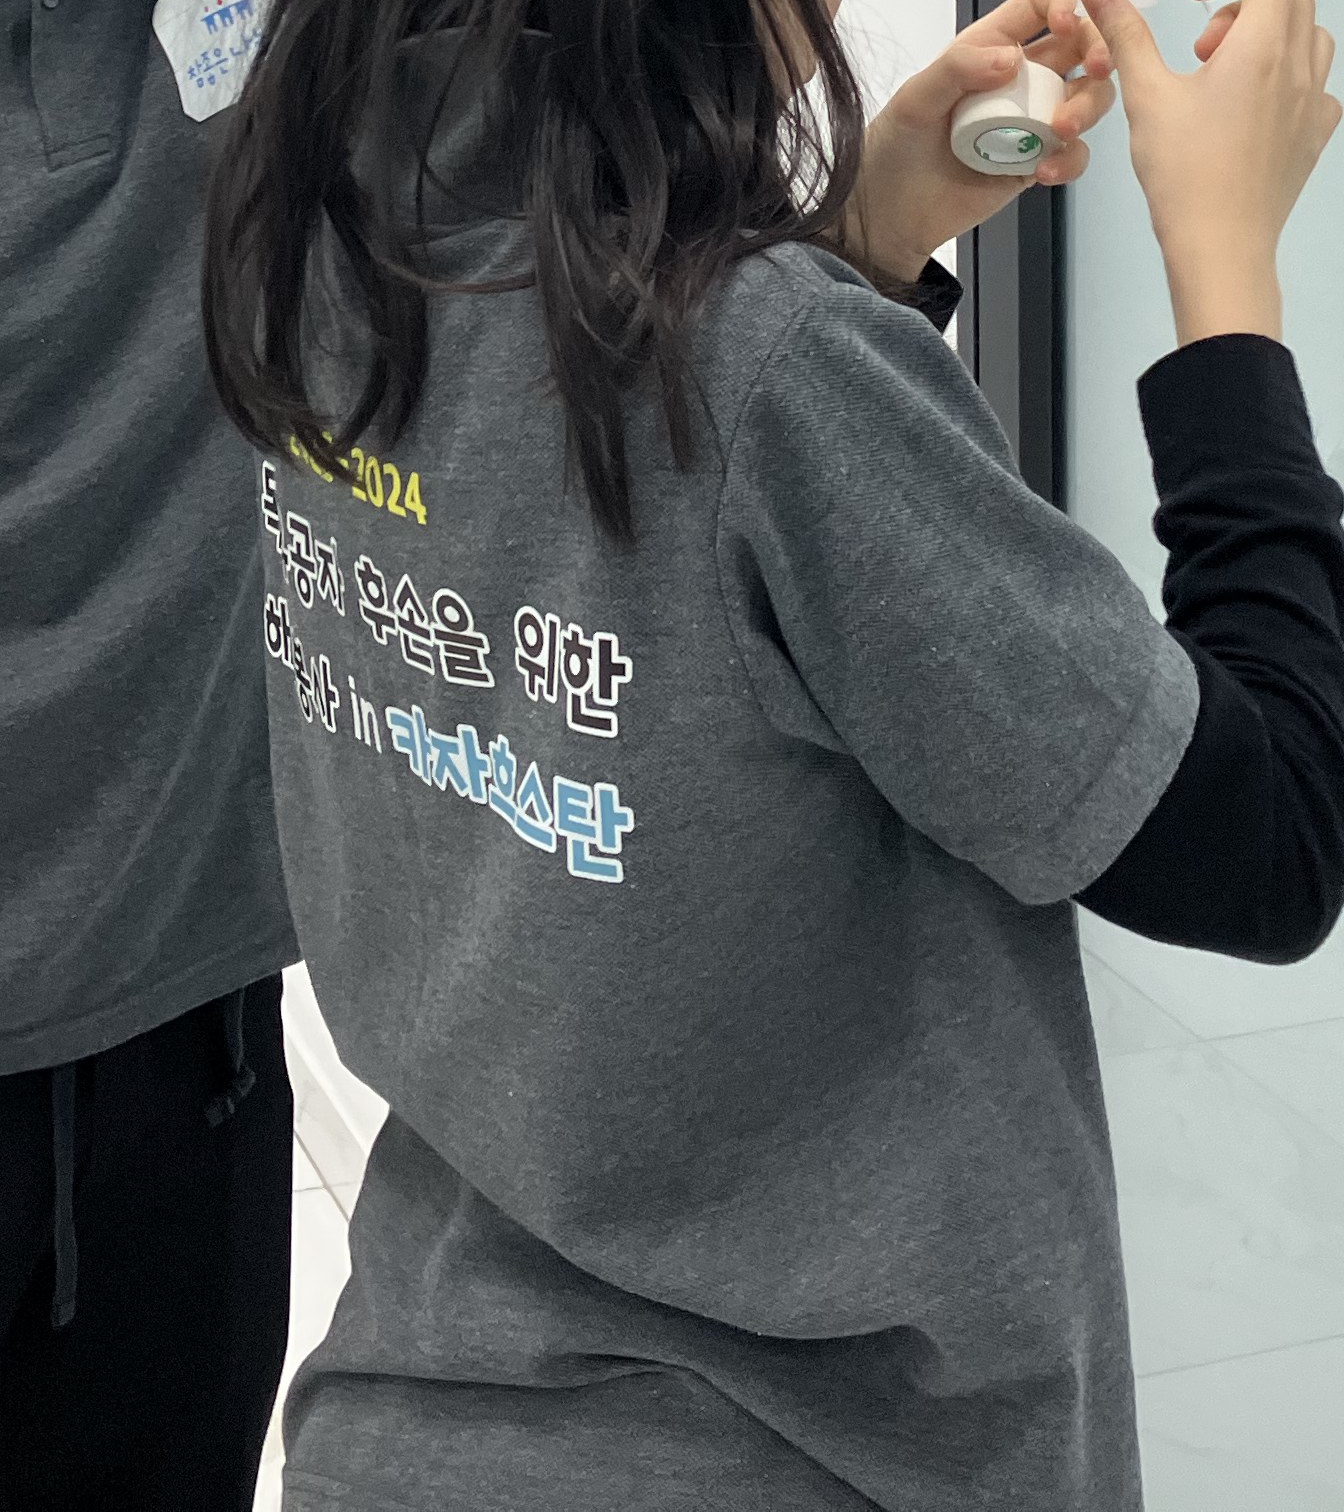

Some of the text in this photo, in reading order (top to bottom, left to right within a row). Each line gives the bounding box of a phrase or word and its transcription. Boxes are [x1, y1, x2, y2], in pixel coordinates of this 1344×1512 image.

[353, 553, 496, 688] 후손을
[513, 604, 633, 739] 위한
[347, 674, 382, 755] in
[384, 703, 635, 884] 카자흐스탄
